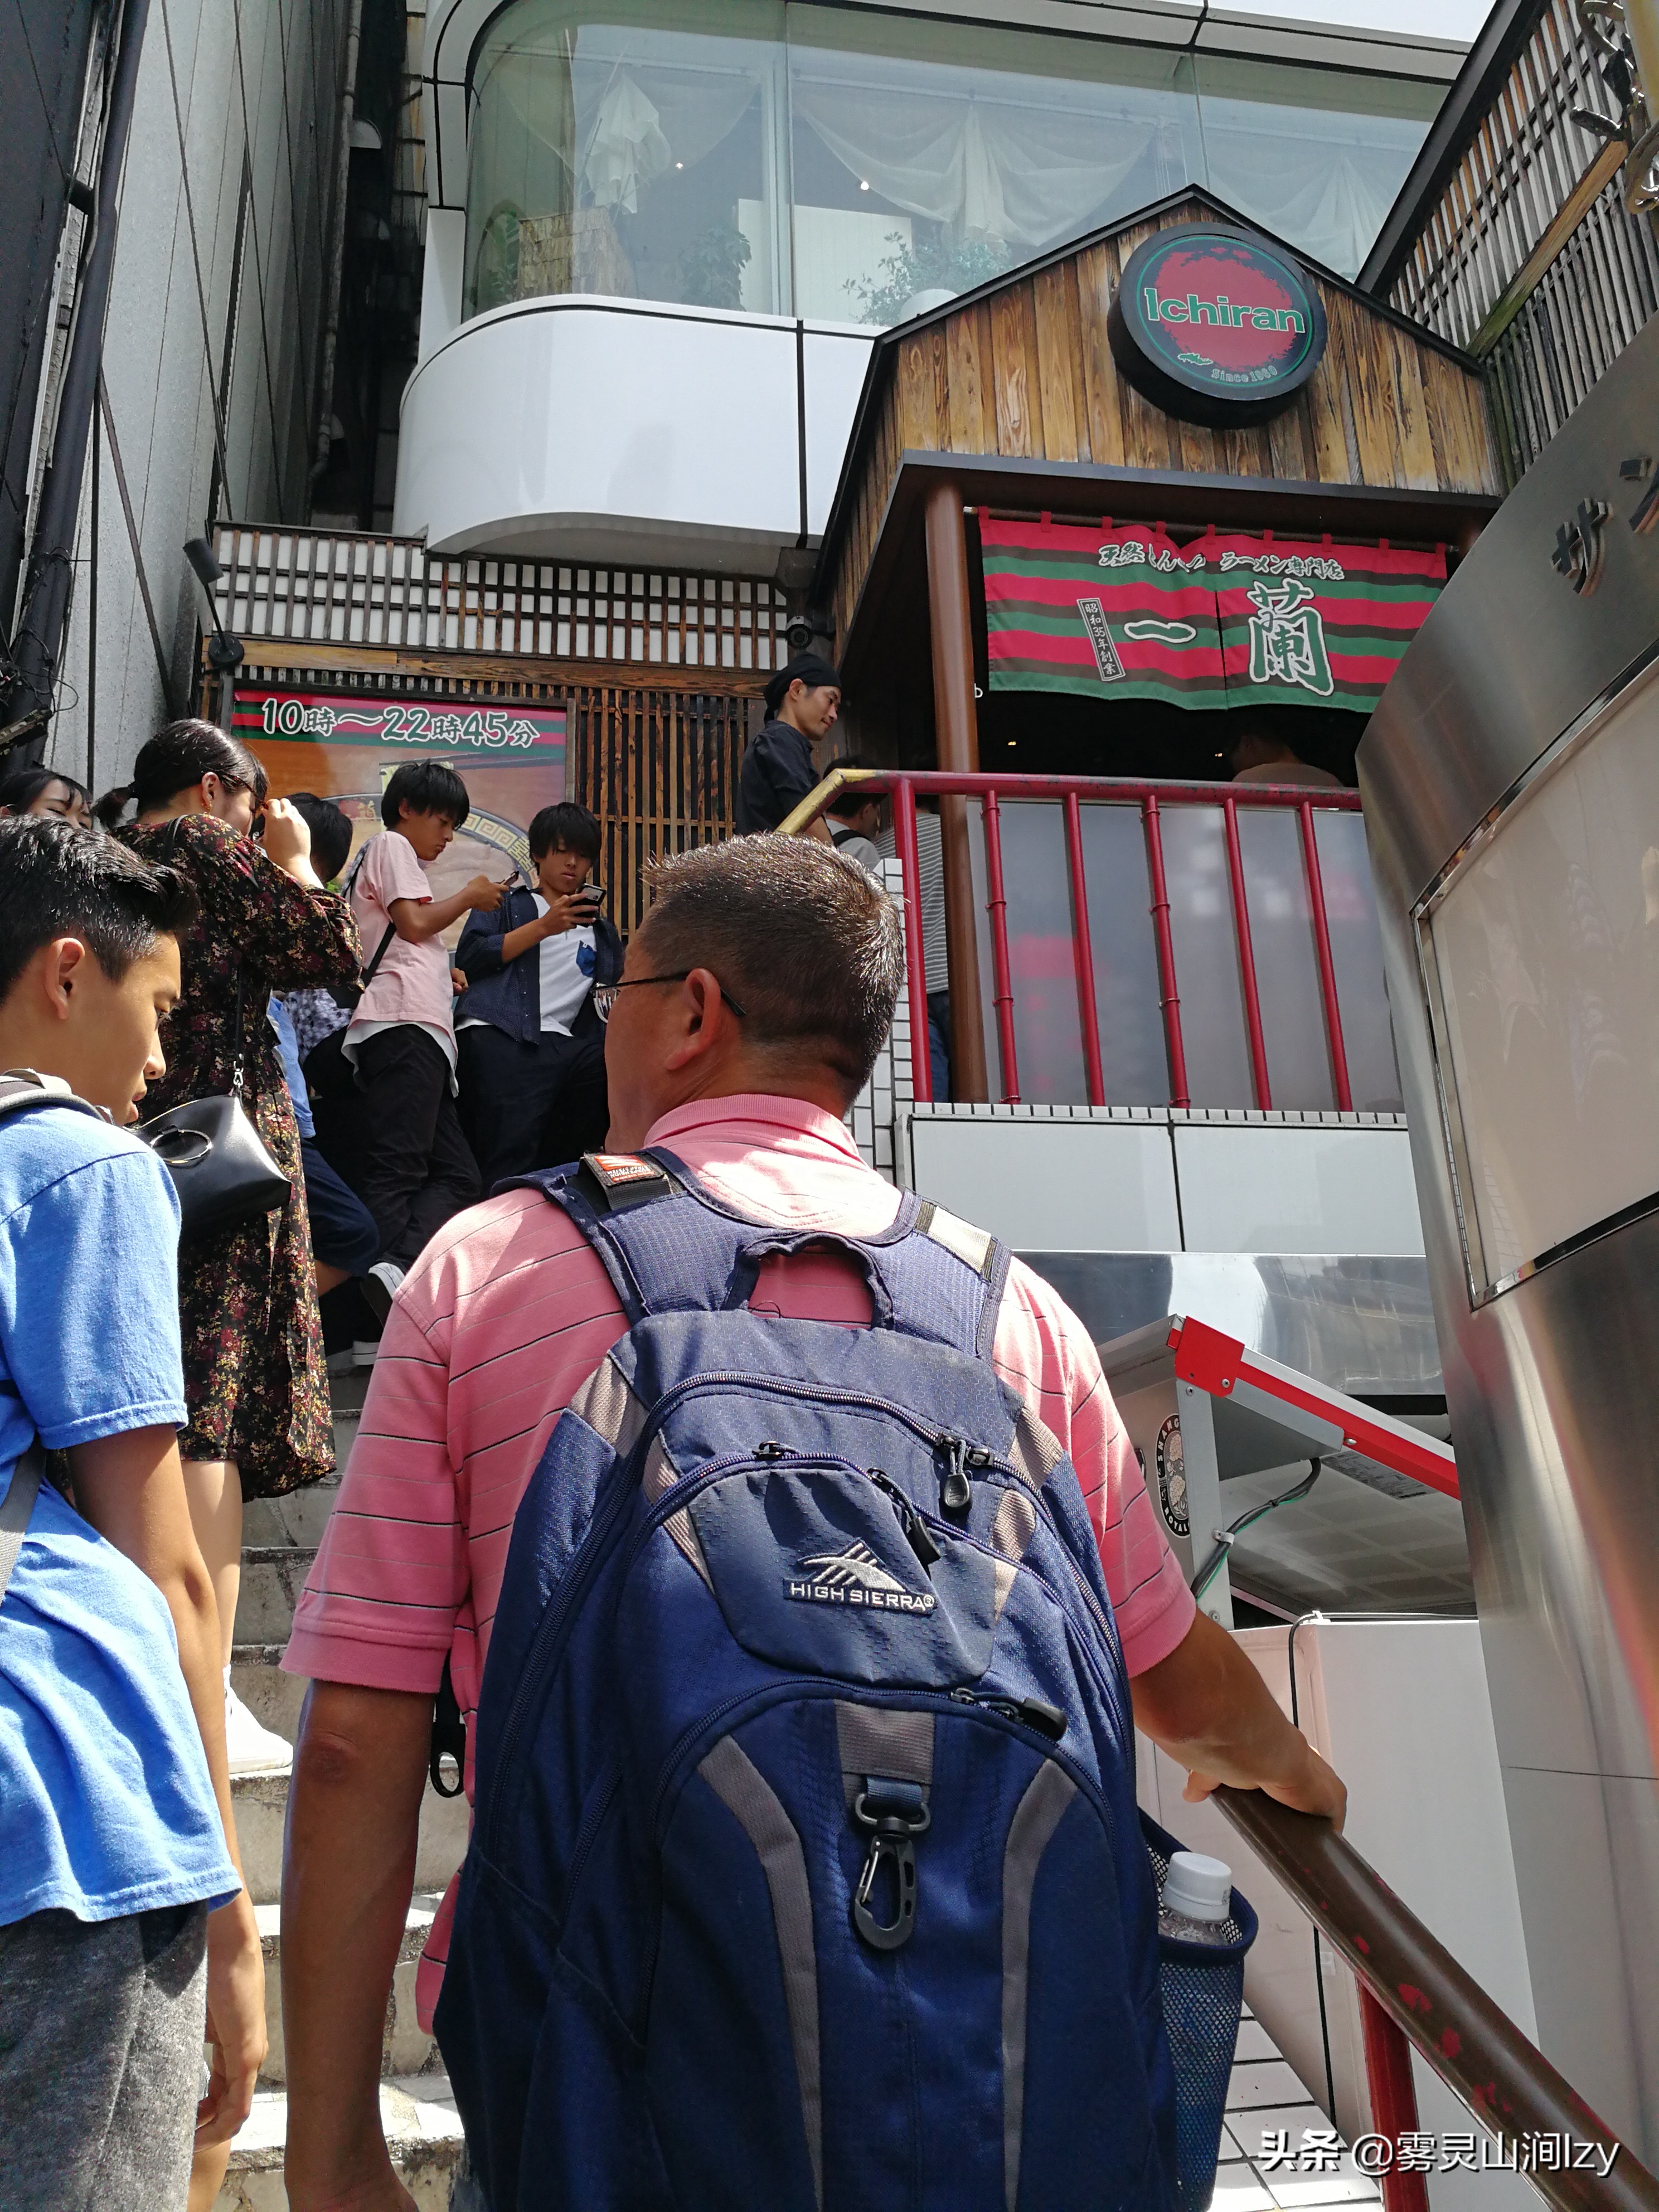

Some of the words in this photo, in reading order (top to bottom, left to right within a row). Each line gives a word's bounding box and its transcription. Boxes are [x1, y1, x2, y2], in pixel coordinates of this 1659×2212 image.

[1144, 287, 1306, 333] Ichiran
[1211, 368, 1249, 383] Since
[1220, 551, 1345, 580] ラーメン専門店
[1084, 603, 1117, 675] 昭和35年創業
[1124, 578, 1335, 696] 一蘭
[790, 1583, 844, 1602] HIGH
